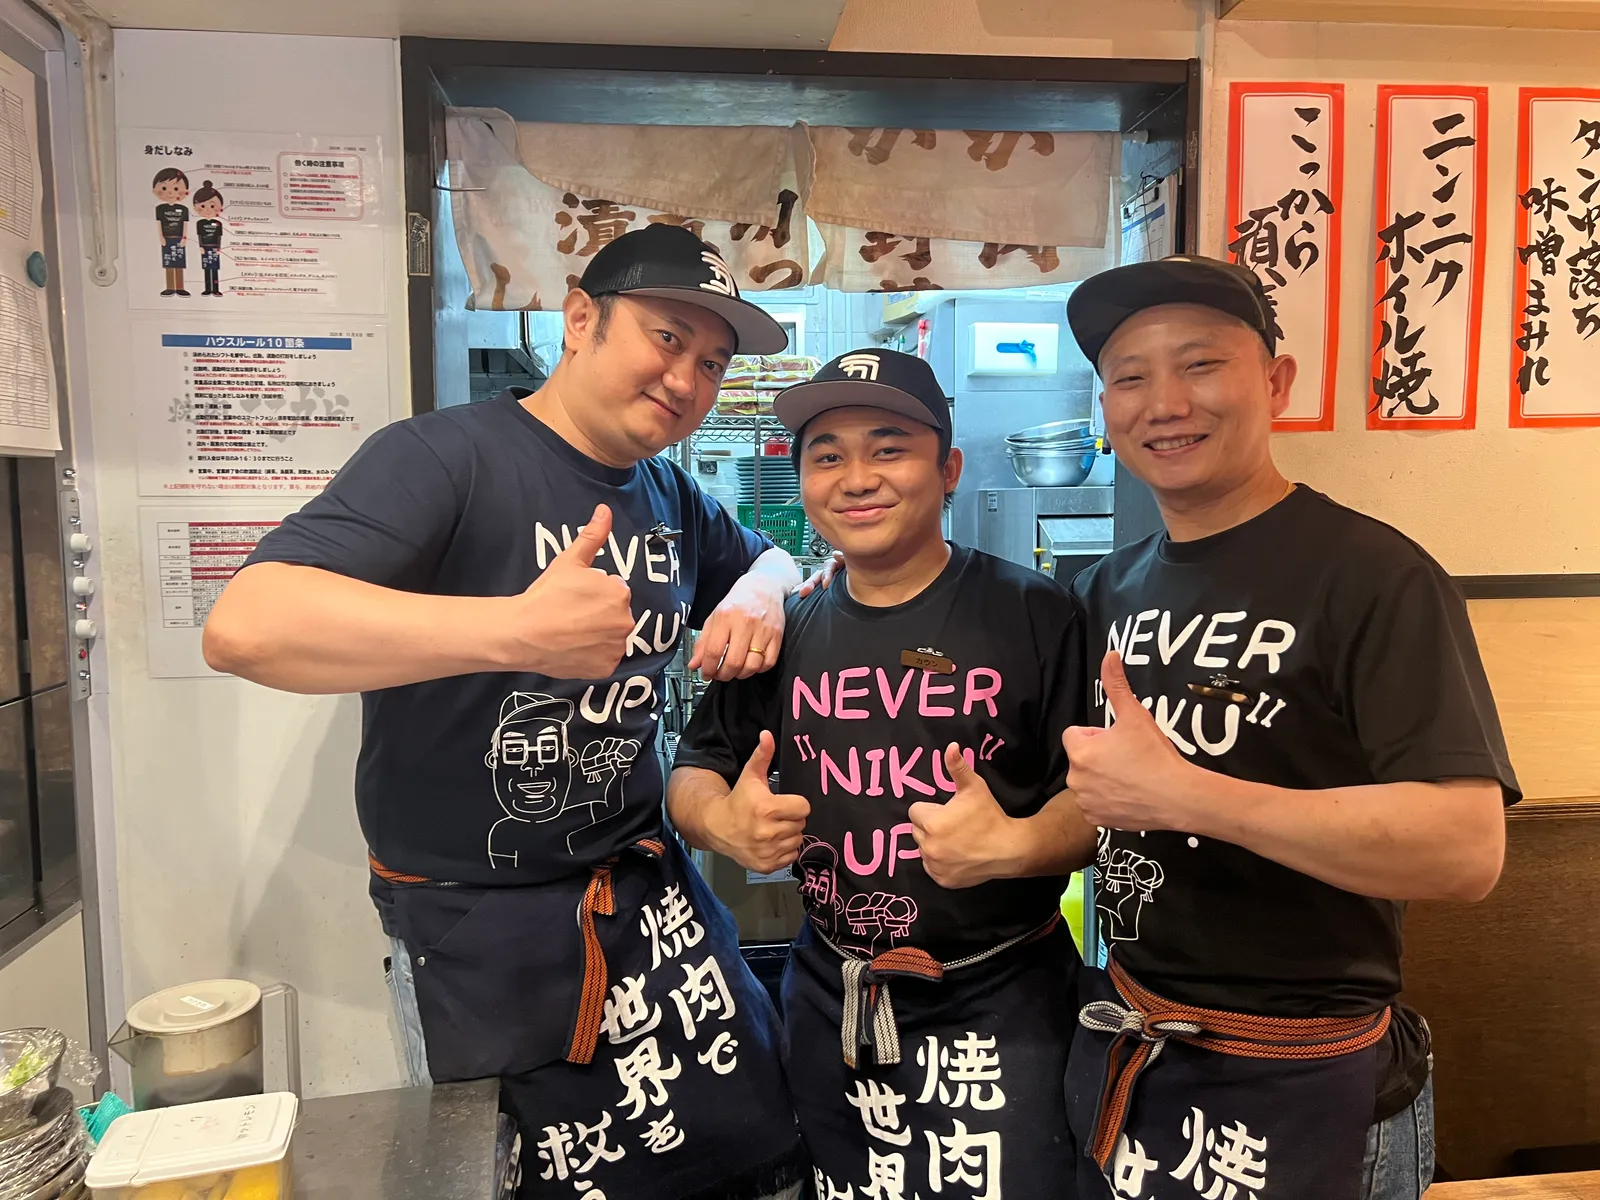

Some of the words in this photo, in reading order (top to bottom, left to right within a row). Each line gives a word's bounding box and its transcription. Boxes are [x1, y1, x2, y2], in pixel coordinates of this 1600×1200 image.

[144, 145, 193, 157] 身だしなみ
[1277, 107, 1335, 278] こっから
[1420, 113, 1476, 307] ニンニク
[1367, 211, 1440, 417] ホイル焼
[535, 521, 681, 586] NVER
[792, 666, 1003, 720] NEVER
[1106, 608, 1297, 674] NEVER
[600, 972, 685, 1154] 世界を
[640, 881, 739, 1075] 焼肉で
